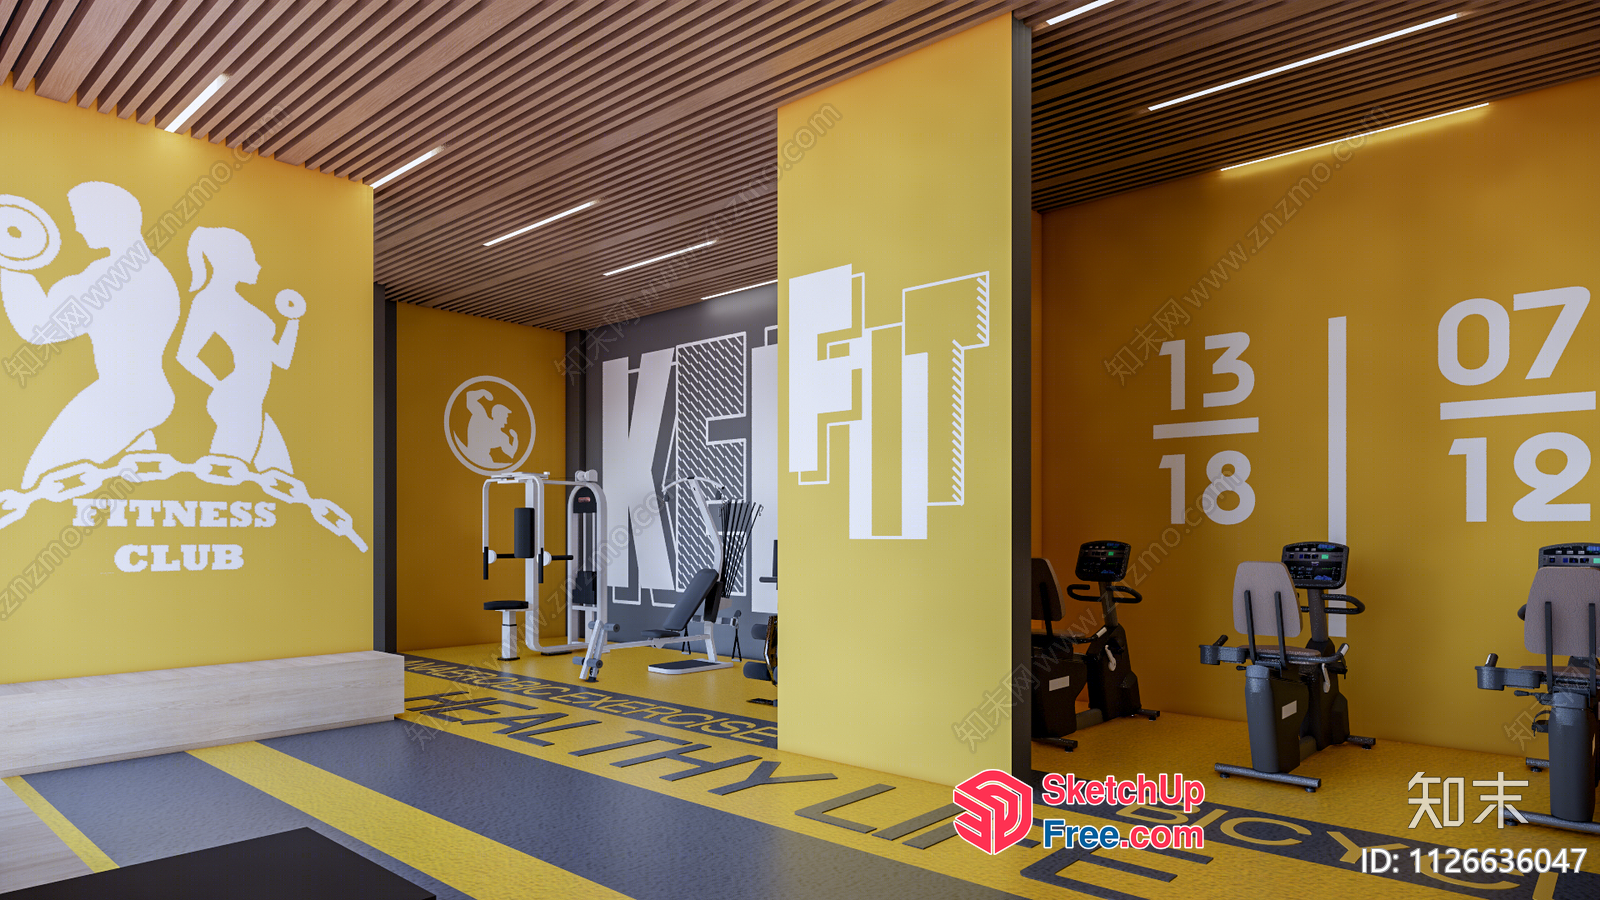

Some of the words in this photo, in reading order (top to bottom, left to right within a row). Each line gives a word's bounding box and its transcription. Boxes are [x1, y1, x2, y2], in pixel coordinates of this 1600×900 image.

[1159, 331, 1255, 411] 13
[1438, 286, 1591, 386] 07
[789, 264, 989, 539] FIT
[73, 498, 277, 527] FITNESS
[1159, 450, 1256, 525] 18
[1448, 431, 1591, 522] 12
[114, 544, 244, 572] CLUB
[548, 690, 777, 743] EXERCISE
